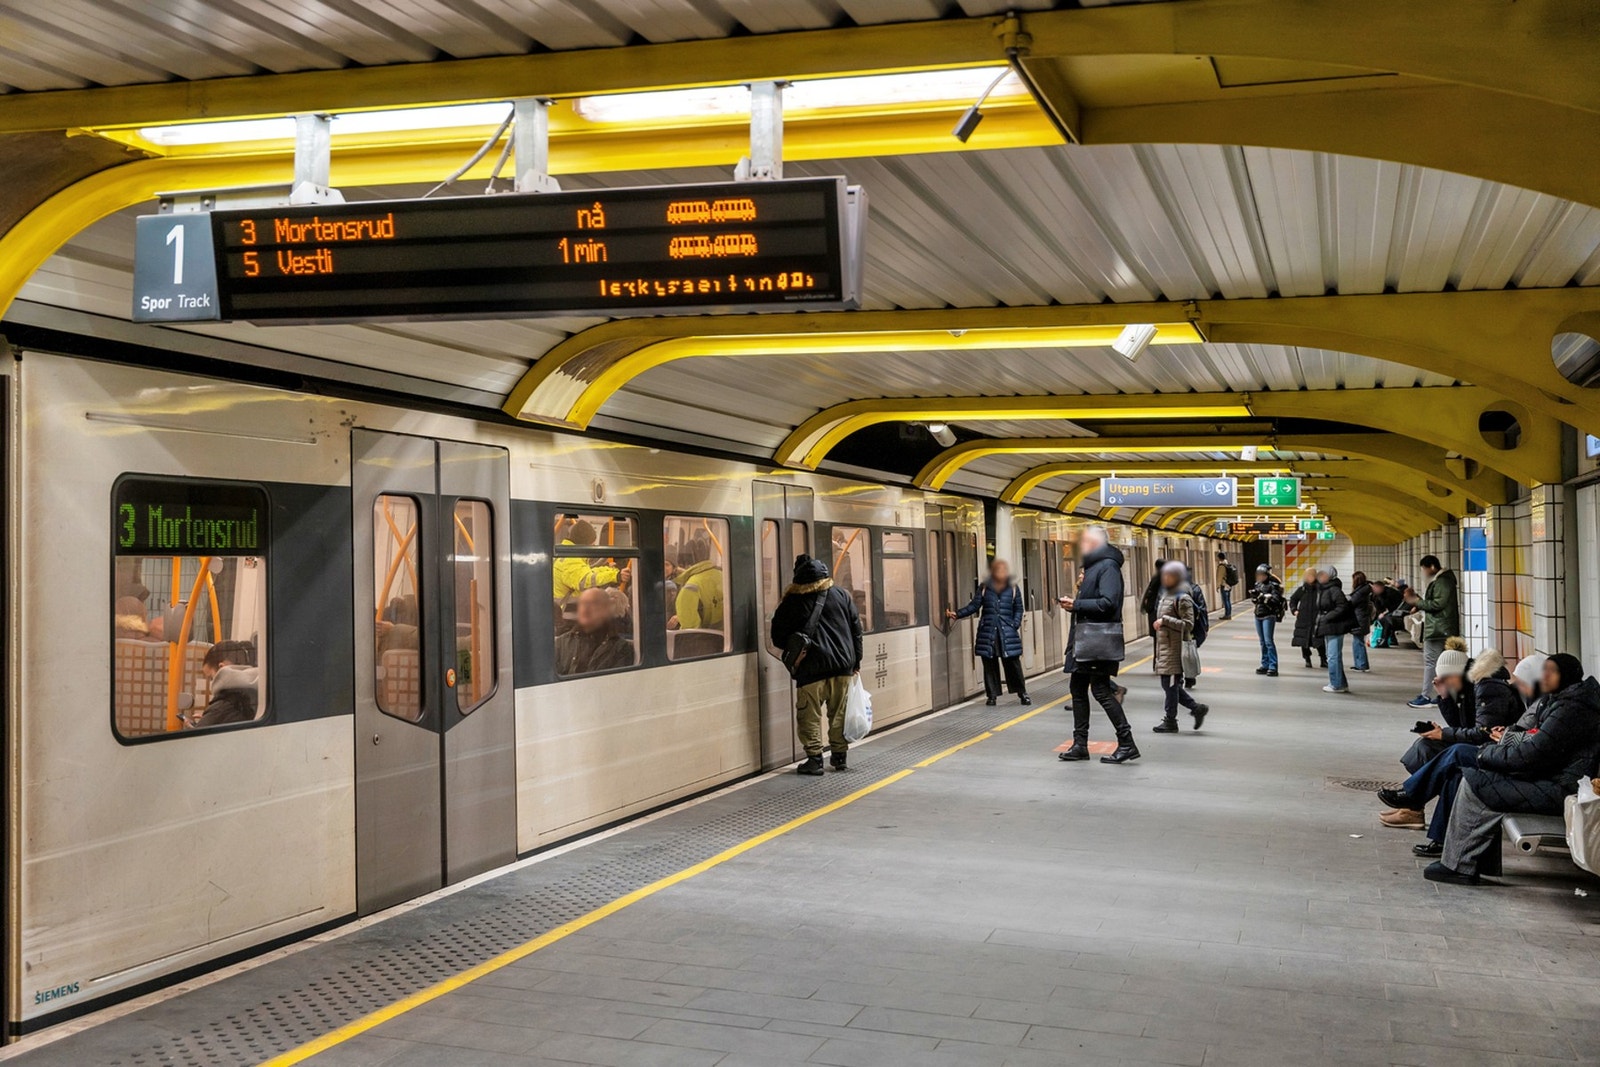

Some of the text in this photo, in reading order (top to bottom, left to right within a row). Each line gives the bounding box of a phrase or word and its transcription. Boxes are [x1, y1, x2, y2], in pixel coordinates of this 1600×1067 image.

[241, 202, 605, 245] 3 Mortensrud nå
[166, 224, 184, 285] 1
[244, 252, 259, 276] 5
[277, 248, 333, 275] Vestli
[141, 294, 210, 311] Spor Track
[1109, 483, 1174, 496] Utgang Exit
[119, 504, 257, 548] 3 Mortensrud
[35, 981, 80, 1004] SIEMENS
